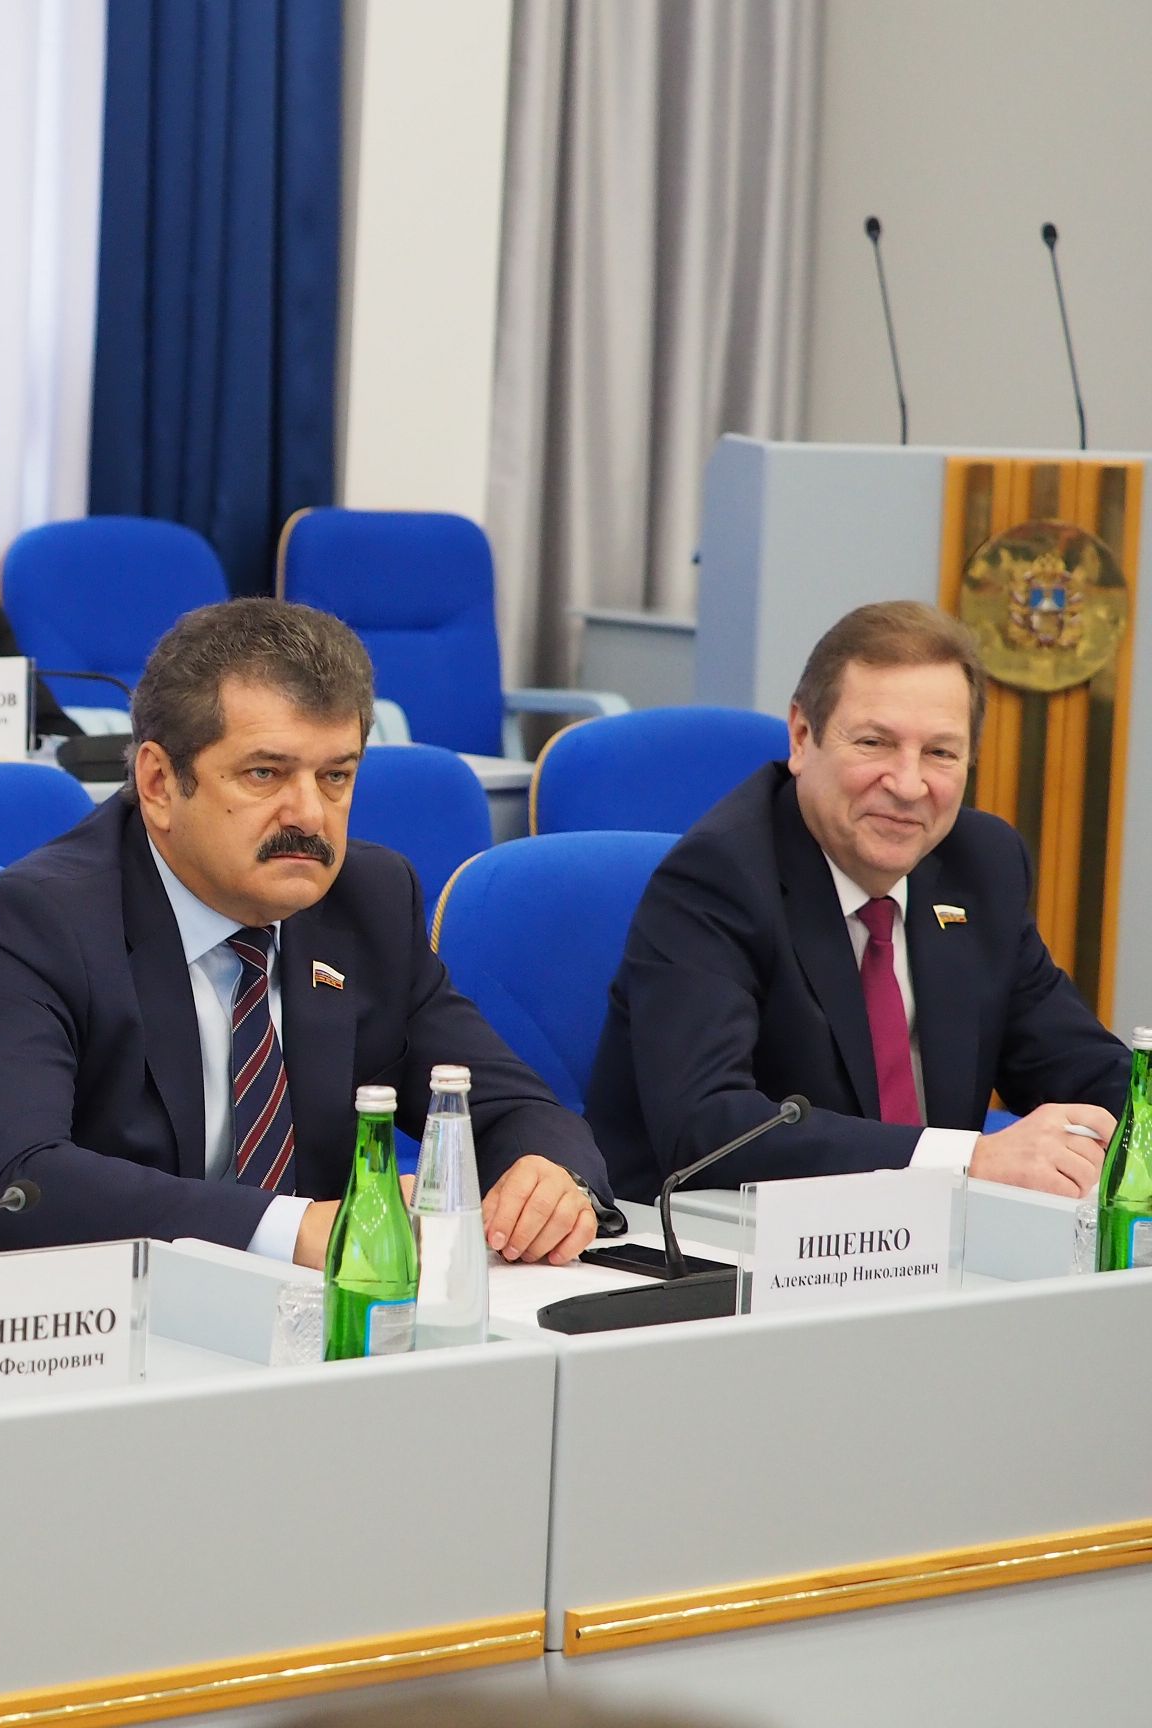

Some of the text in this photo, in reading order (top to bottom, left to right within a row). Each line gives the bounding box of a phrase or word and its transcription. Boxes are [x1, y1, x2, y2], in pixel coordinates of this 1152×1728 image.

[798, 1227, 911, 1261] ИЩЕНКО
[770, 1262, 939, 1289] Александр Николаевич
